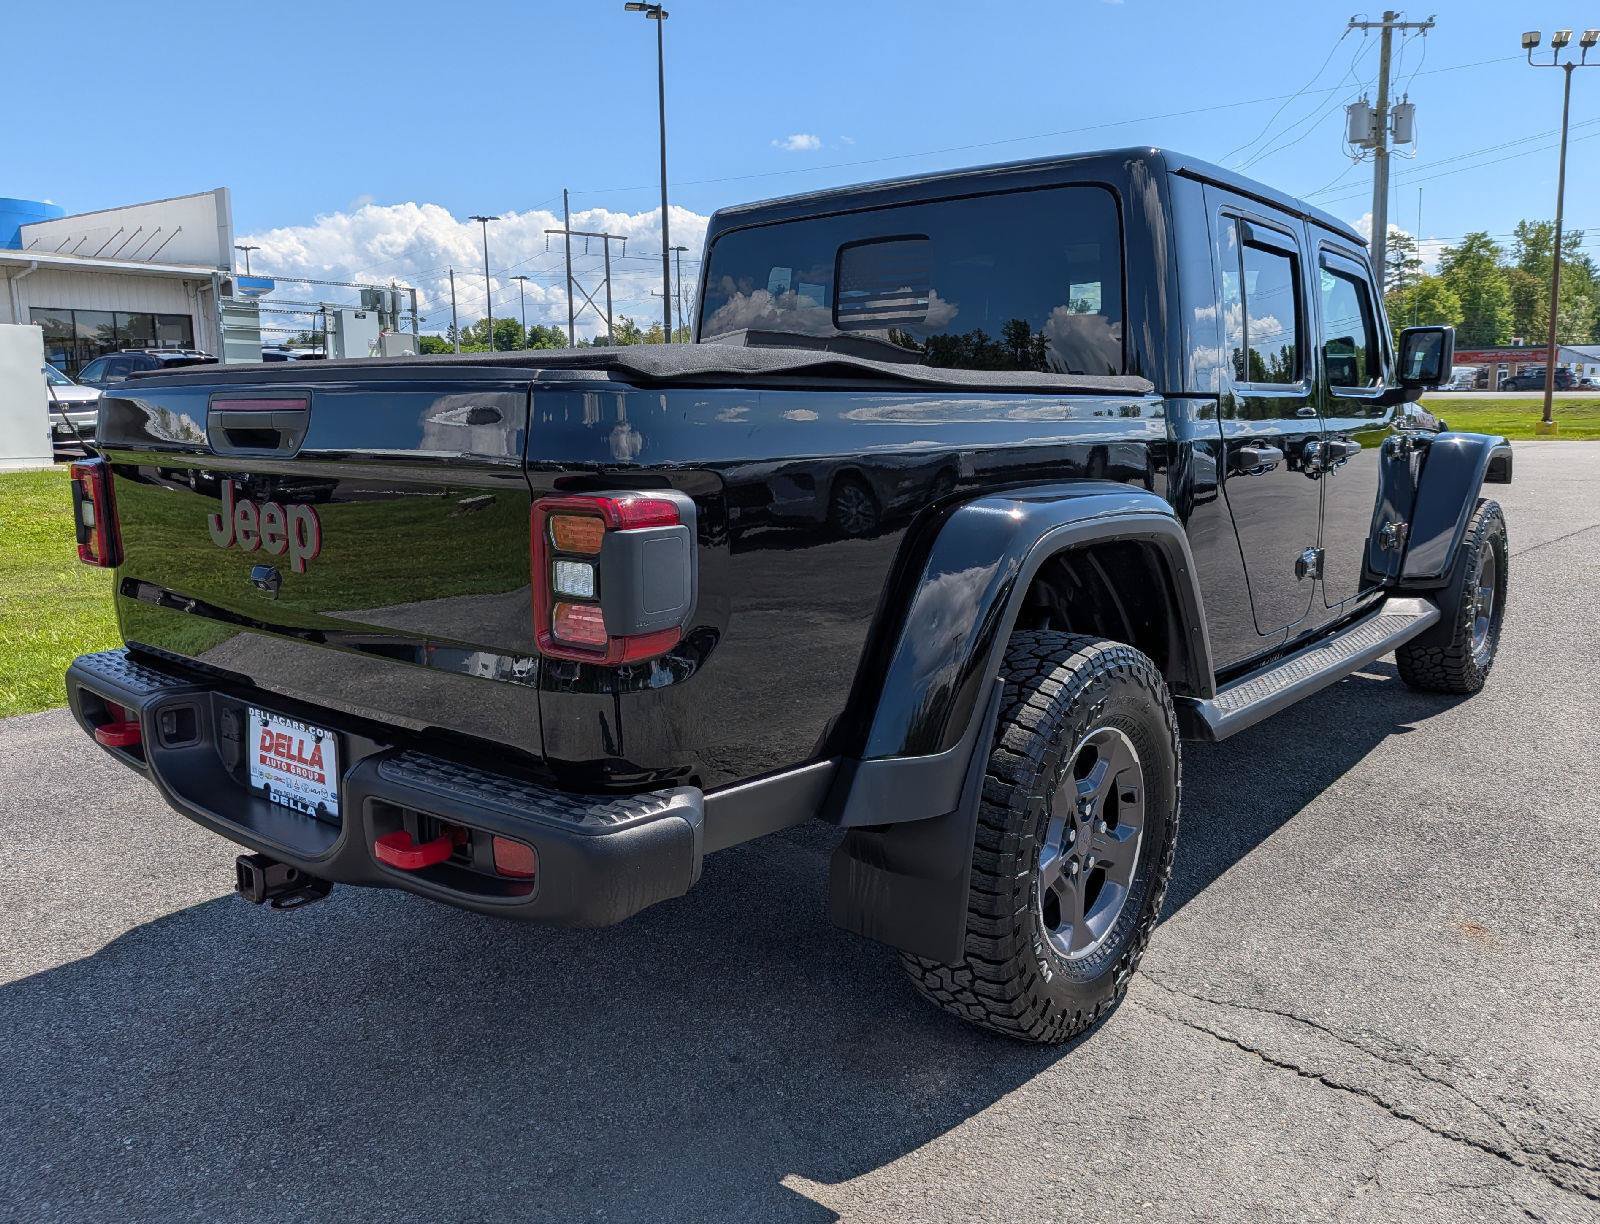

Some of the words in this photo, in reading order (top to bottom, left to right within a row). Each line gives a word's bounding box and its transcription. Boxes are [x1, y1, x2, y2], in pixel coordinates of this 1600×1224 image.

[207, 479, 322, 574] Jeep
[248, 707, 333, 740] DELLACARS.COM
[260, 728, 324, 771] DELLA
[266, 757, 287, 770] AUTO
[290, 765, 319, 781] GROUP
[269, 794, 317, 817] DELLA
